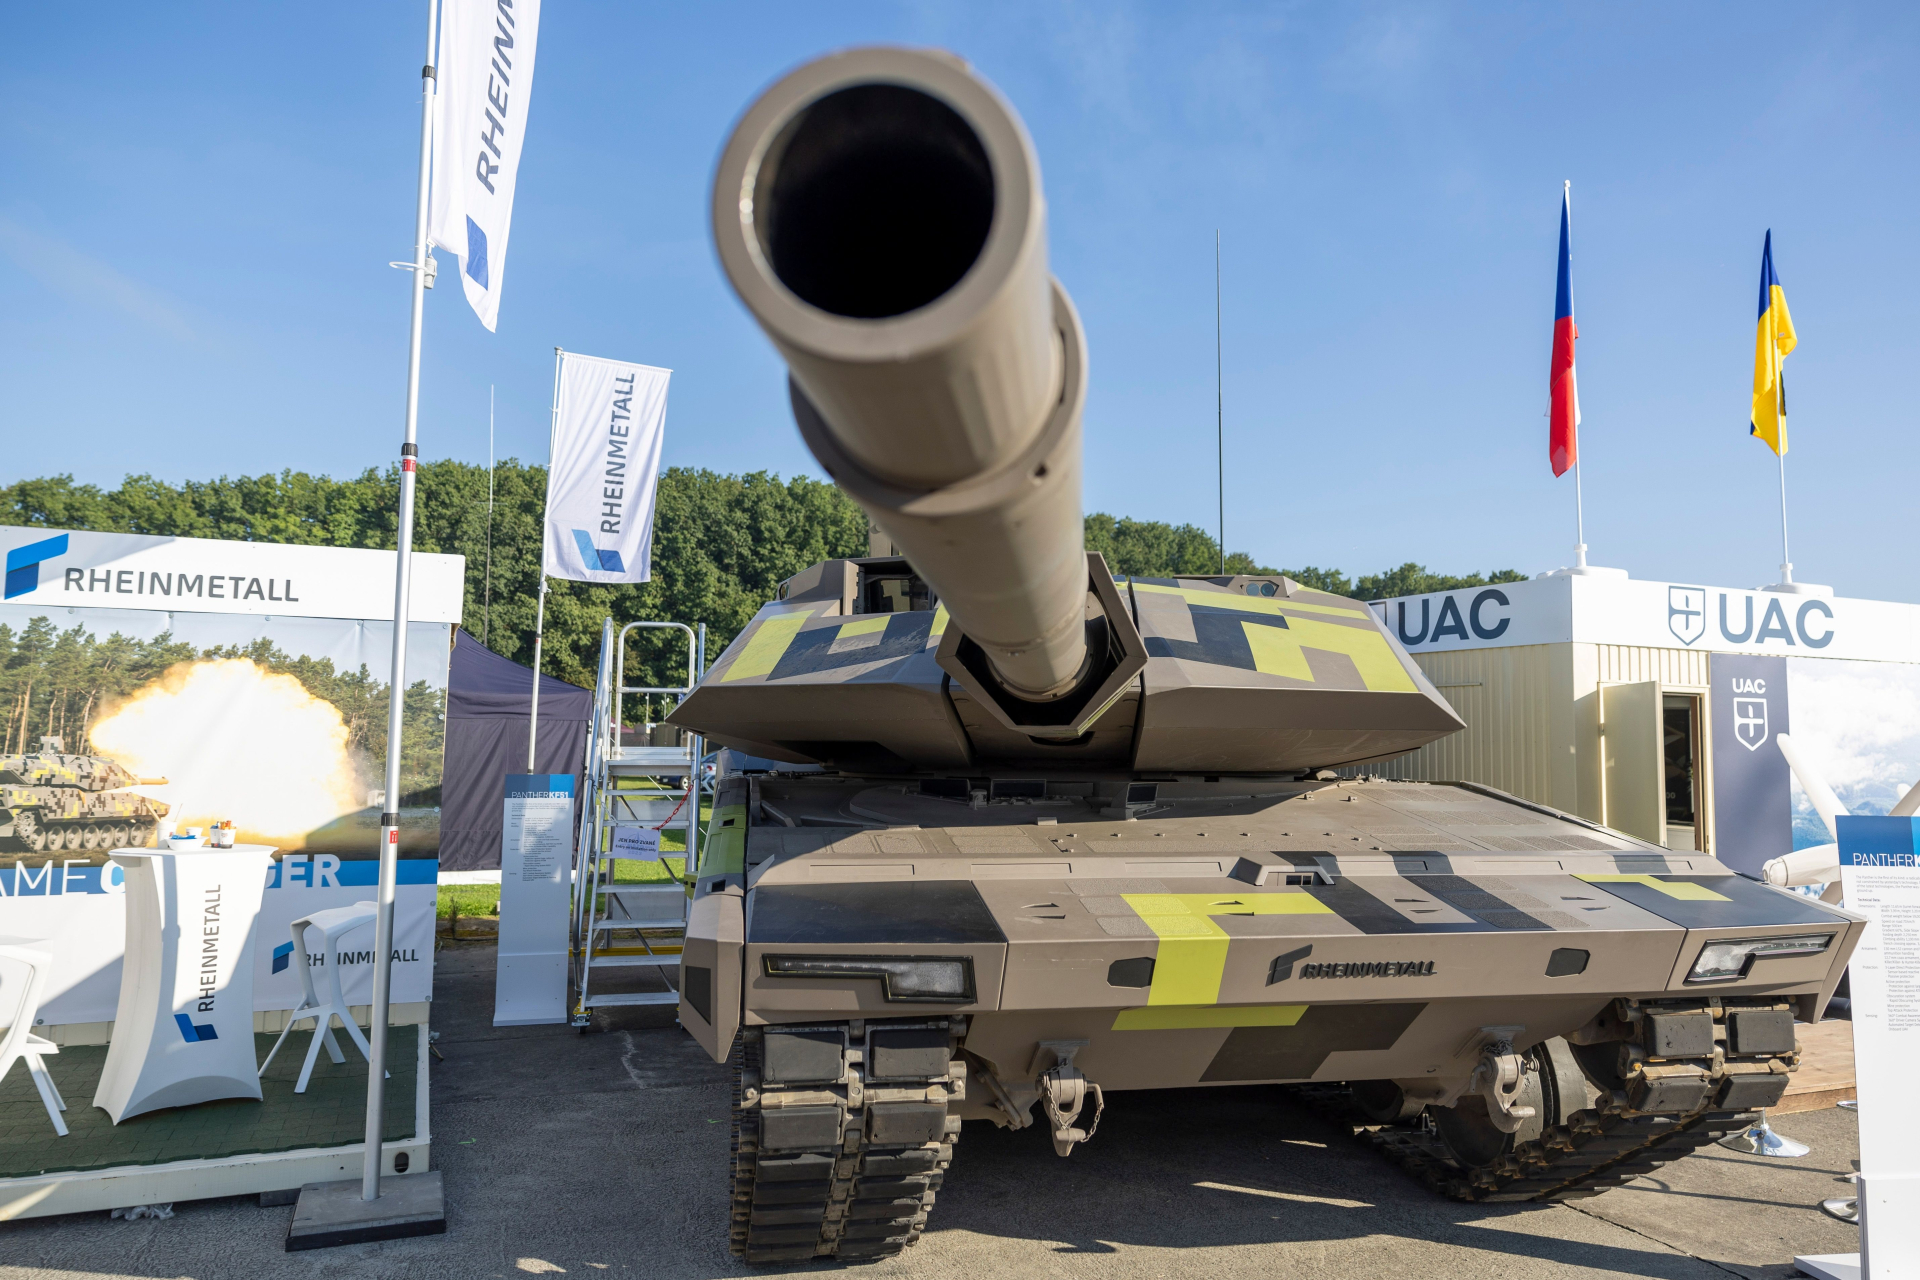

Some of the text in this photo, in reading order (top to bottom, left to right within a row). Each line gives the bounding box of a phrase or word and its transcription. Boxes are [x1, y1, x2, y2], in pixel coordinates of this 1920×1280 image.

[600, 372, 636, 535] RHEINMETALL
[64, 567, 299, 602] RHEINMETALL
[1398, 589, 1511, 646] UAC
[1719, 593, 1835, 649] UAC
[1732, 678, 1766, 694] UAC
[198, 884, 222, 1013] RHEINMETALL
[1300, 960, 1438, 979] RHEINMETALL
